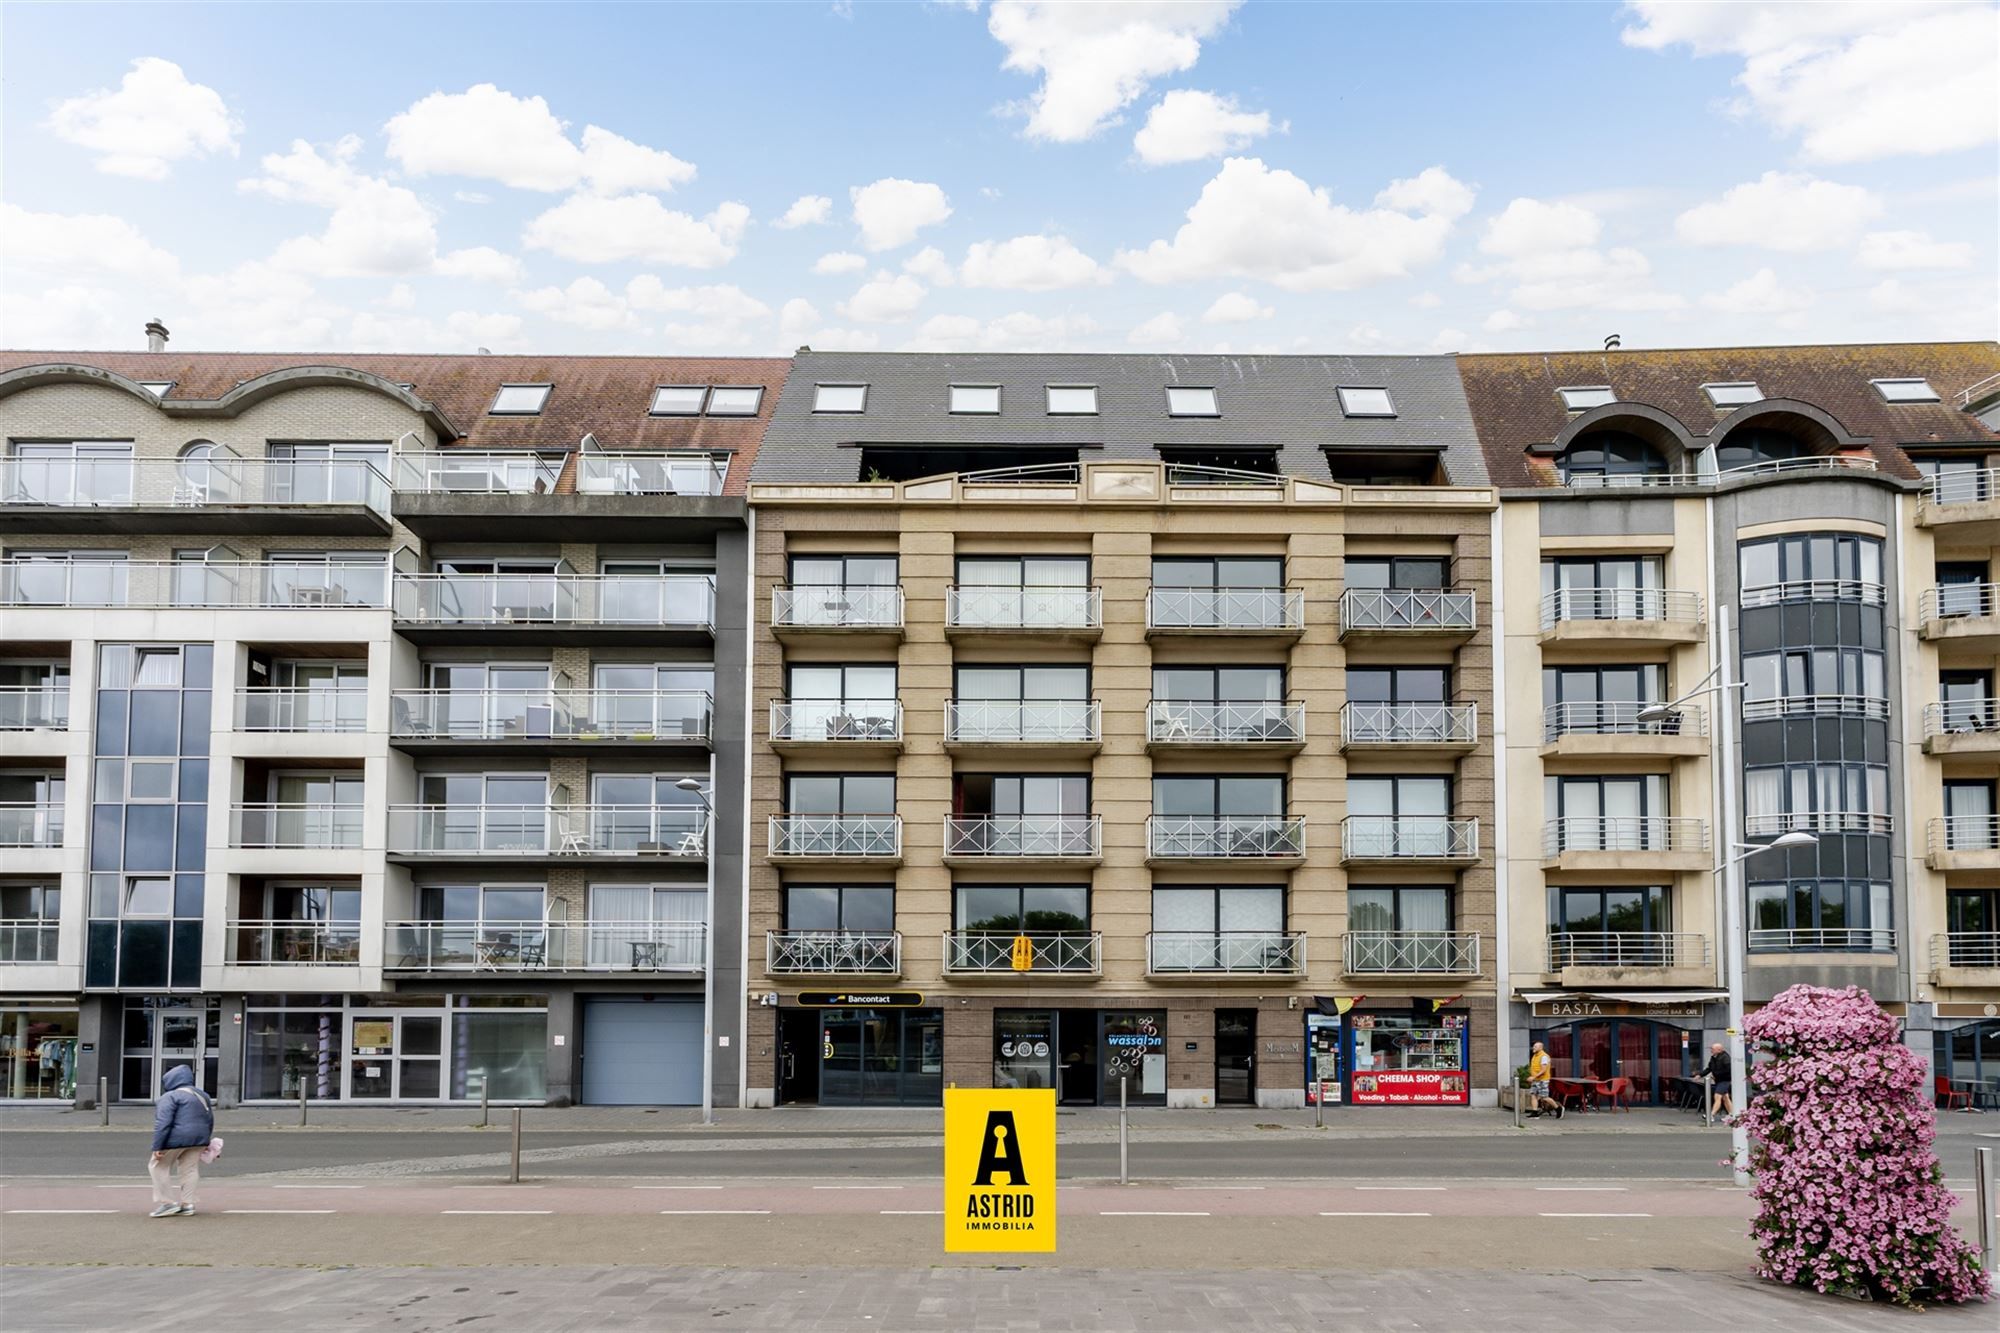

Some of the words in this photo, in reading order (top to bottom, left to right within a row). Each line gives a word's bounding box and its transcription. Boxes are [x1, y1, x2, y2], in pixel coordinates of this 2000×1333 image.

[848, 995, 890, 1003] Bancontact
[1552, 1003, 1602, 1015] BASTA
[1378, 1075, 1414, 1083] CHEEMA
[1416, 1075, 1440, 1083] SHOP
[1359, 1094, 1385, 1102] Voeding
